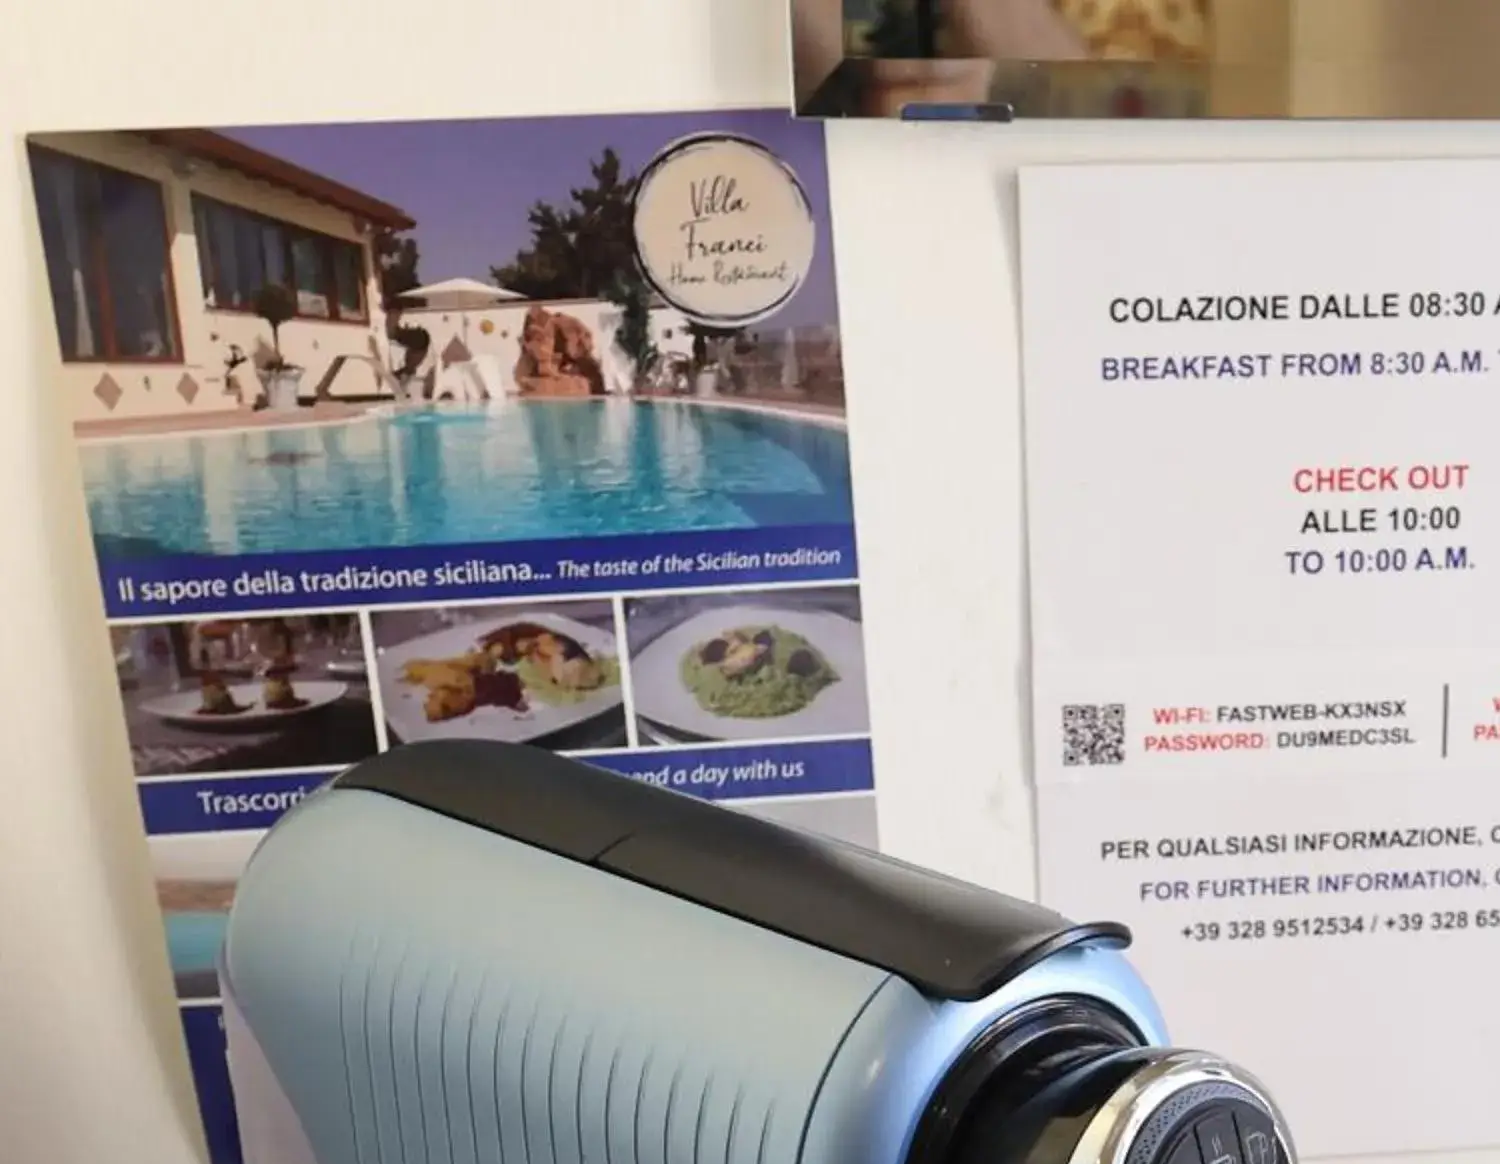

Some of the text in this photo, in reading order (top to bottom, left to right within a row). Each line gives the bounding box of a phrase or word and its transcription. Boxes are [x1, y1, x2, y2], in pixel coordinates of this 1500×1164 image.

[690, 175, 749, 218] Villa
[679, 218, 768, 261] Franci
[1109, 295, 1289, 323] COLAZIONE
[1299, 293, 1400, 319] DALLE
[1409, 291, 1485, 317] 08:30
[1101, 355, 1272, 380] BREAKFAST
[1281, 352, 1362, 377] FROM
[1370, 351, 1424, 375] 8:30
[1432, 350, 1489, 373] A.M.
[1294, 465, 1470, 493] CHECK OUT
[1300, 506, 1461, 534] ALLE 10:00
[1284, 546, 1475, 574] TO 10:00 A.M.
[118, 548, 842, 605] Il sapore della tradizione siciliana... The taste of the Sicilian tradition
[1153, 700, 1408, 724] WI-FI: FASTWEB-KX3NSX
[1144, 727, 1416, 752] PASSWORD: DU9MEDC3SL
[673, 770, 688, 786] a
[690, 764, 729, 788] day
[732, 760, 778, 781] with
[781, 761, 805, 778] us
[1100, 840, 1150, 860] PER
[1156, 834, 1287, 858] QUALSIASI
[1295, 826, 1483, 851] INFORMAZIONE,
[1140, 881, 1190, 901] FOR
[1197, 875, 1310, 899] FURTHER
[1317, 869, 1487, 894] INFORMATION,
[1181, 922, 1220, 941] +39
[1228, 920, 1266, 939] 328
[1273, 916, 1364, 937] 9512534
[1384, 913, 1423, 932] +39
[1431, 911, 1468, 929] 328
